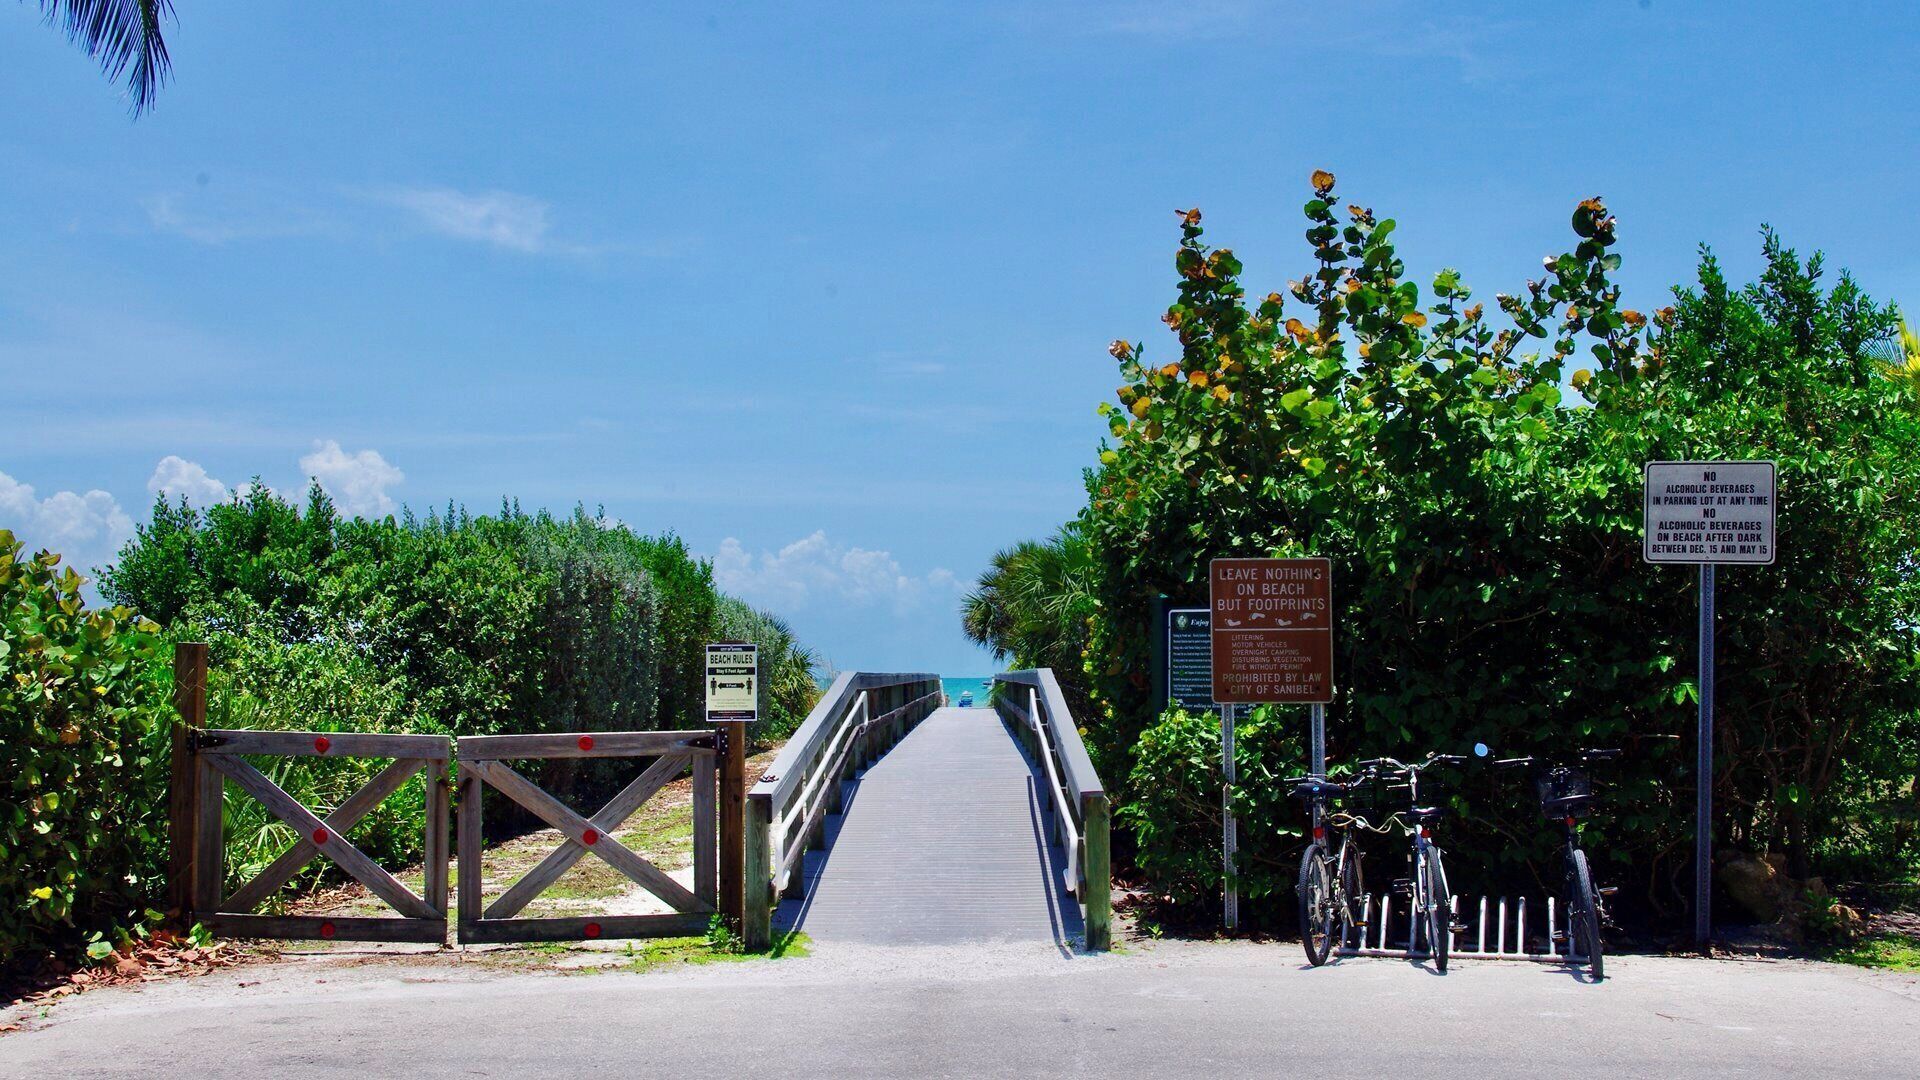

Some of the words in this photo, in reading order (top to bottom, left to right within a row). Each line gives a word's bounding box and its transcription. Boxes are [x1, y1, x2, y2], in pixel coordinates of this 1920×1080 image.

[1704, 472, 1716, 481] NO
[1666, 484, 1707, 493] ALCOHOLIC
[1710, 484, 1755, 493] BEVERAGES
[1653, 496, 1660, 505] IN
[1664, 496, 1697, 505] PARKING
[1700, 496, 1714, 505] LOT
[1717, 496, 1726, 505] AT
[1730, 496, 1746, 505] ANY
[1749, 496, 1768, 505] TIME
[1703, 508, 1716, 518] NO
[1658, 522, 1706, 530] ALCOHOLIC
[1710, 522, 1762, 530] BEVERAGES
[1657, 533, 1669, 542] ON
[1673, 533, 1701, 542] BEACH
[1705, 533, 1733, 542] AFTER
[1738, 533, 1762, 542] DARK
[1652, 545, 1686, 553] BETWEEN
[1690, 545, 1706, 553] DEC.
[1710, 545, 1717, 553] 15
[1721, 545, 1736, 553] AND
[1740, 545, 1756, 554] MAY
[1760, 546, 1767, 554] 15
[1220, 568, 1258, 580] LEAVE
[1266, 568, 1321, 580] NOTHING
[1237, 584, 1255, 595] ON
[1262, 583, 1304, 595] BEACH
[1218, 599, 1241, 611] BUT
[1248, 598, 1325, 610] FOOTPRINTS
[710, 655, 731, 664] BEACH
[733, 655, 753, 664] RULES
[1223, 673, 1280, 682] PROHIBITED
[1286, 673, 1298, 682] BY
[1302, 673, 1321, 682] LAW
[1230, 685, 1252, 694] CITY
[1256, 685, 1269, 694] OF
[1274, 685, 1315, 694] SANIBEL
